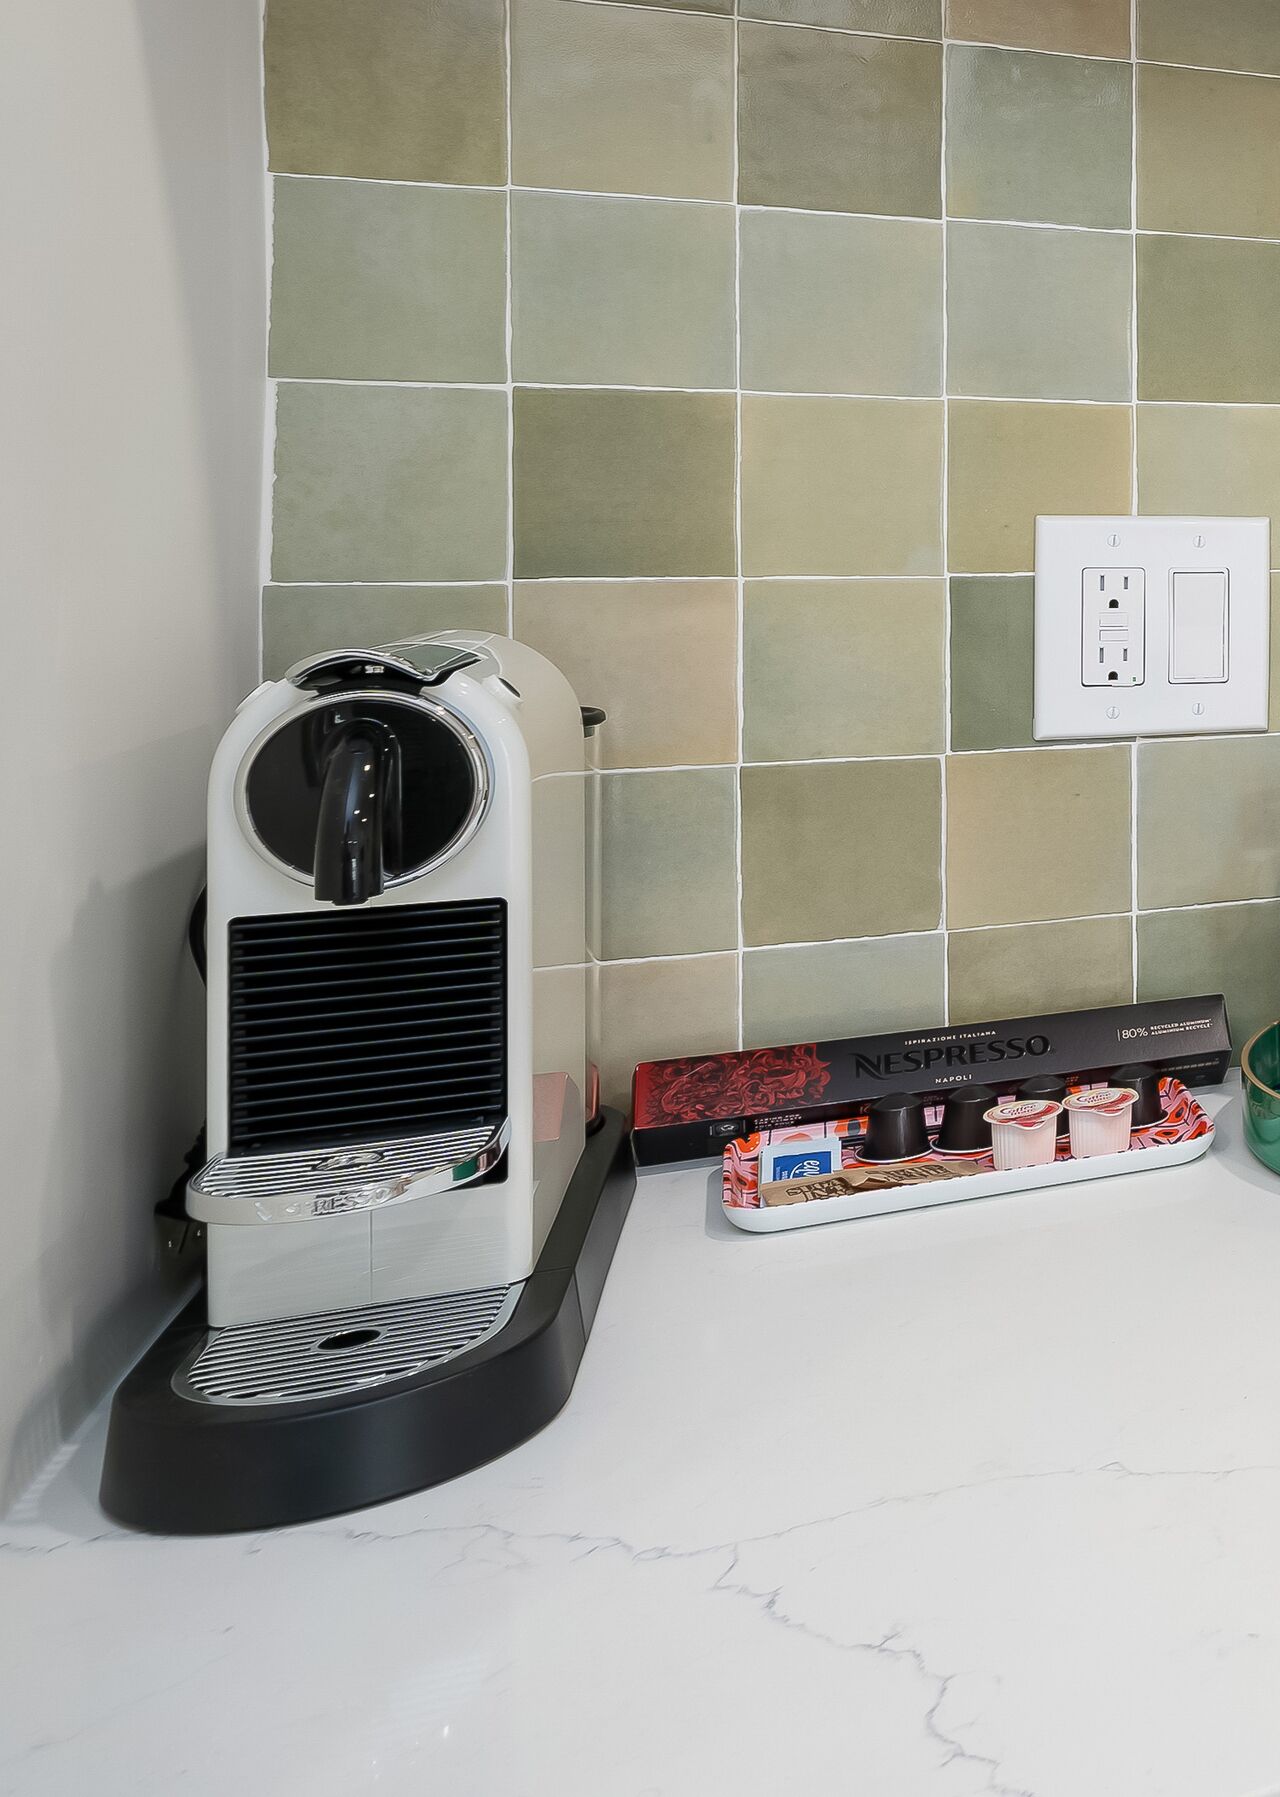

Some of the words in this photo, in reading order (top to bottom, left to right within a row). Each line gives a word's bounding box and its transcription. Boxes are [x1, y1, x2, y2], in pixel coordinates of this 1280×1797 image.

[1121, 1027, 1149, 1039] 80%
[1150, 1022, 1179, 1031] RECYCLED
[904, 1035, 957, 1046] ISPIRAZIONE
[959, 1030, 997, 1039] ITALIANA
[850, 1034, 1052, 1081] NESPRESSO
[935, 1073, 973, 1084] NAPOLI
[795, 1159, 820, 1177] equ
